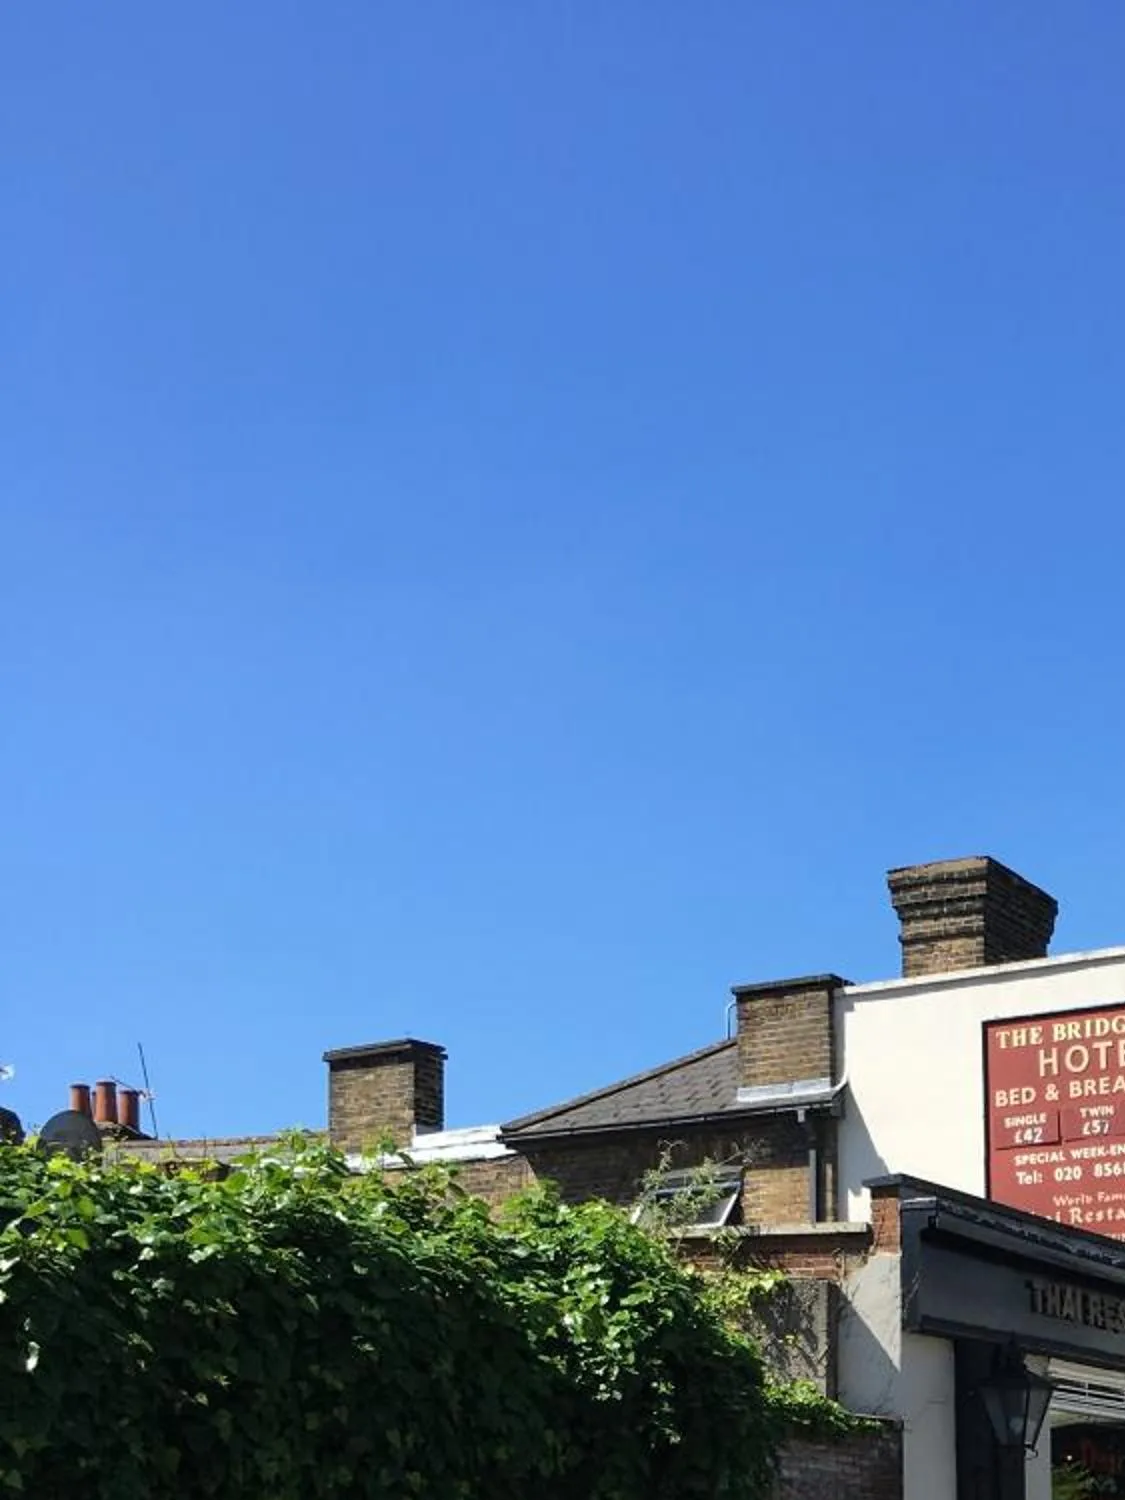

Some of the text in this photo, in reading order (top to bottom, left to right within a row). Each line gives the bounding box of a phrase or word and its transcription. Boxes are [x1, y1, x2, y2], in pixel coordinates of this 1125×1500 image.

[996, 1027, 1043, 1049] THE
[995, 1087, 1036, 1108] BED
[1045, 1083, 1060, 1101] &
[1004, 1112, 1047, 1128] SINGLE
[1080, 1104, 1115, 1119] TWIN
[1014, 1127, 1044, 1144] £42
[1013, 1151, 1066, 1167] SPECIAL
[1016, 1170, 1043, 1185] Tel:
[1054, 1165, 1082, 1182] 020
[1032, 1279, 1083, 1323] THAI
